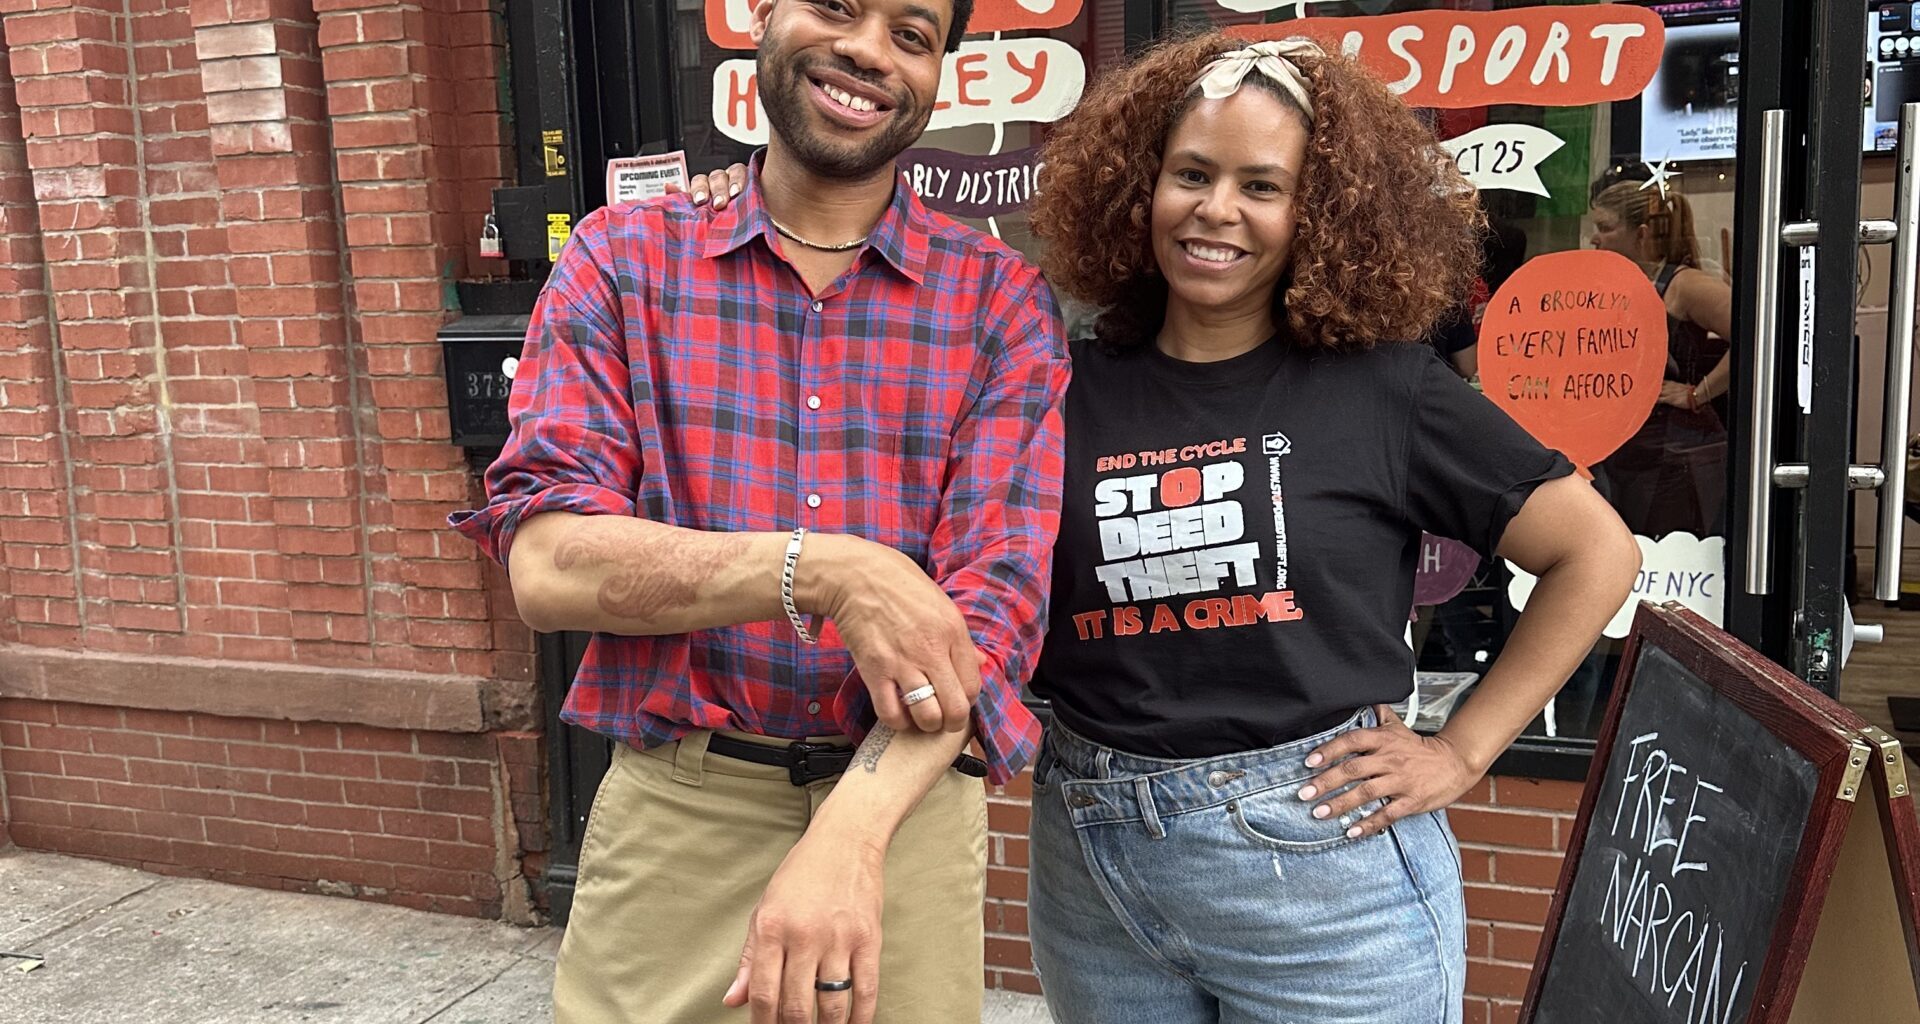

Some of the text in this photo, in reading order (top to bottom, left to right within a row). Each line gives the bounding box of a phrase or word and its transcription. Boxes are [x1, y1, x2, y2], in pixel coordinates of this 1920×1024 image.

[620, 168, 680, 181] UPCOMING EVENTS
[1491, 140, 1526, 174] 25
[1508, 290, 1632, 315] A BROOKLYN
[1496, 327, 1639, 358] EVERY FAMILY
[1508, 373, 1634, 401] CAN AFFORD
[1096, 437, 1247, 472] END THE CYCLE
[1094, 460, 1245, 517] STOP
[1098, 500, 1245, 561] DEED
[1095, 541, 1261, 603] THEFT
[1632, 569, 1715, 598] OF NYC
[1072, 609, 1107, 640] IT
[1113, 605, 1144, 636] IS
[1149, 603, 1182, 633] A
[1611, 732, 1724, 878] FREE
[1600, 852, 1749, 1024] NARCAN
